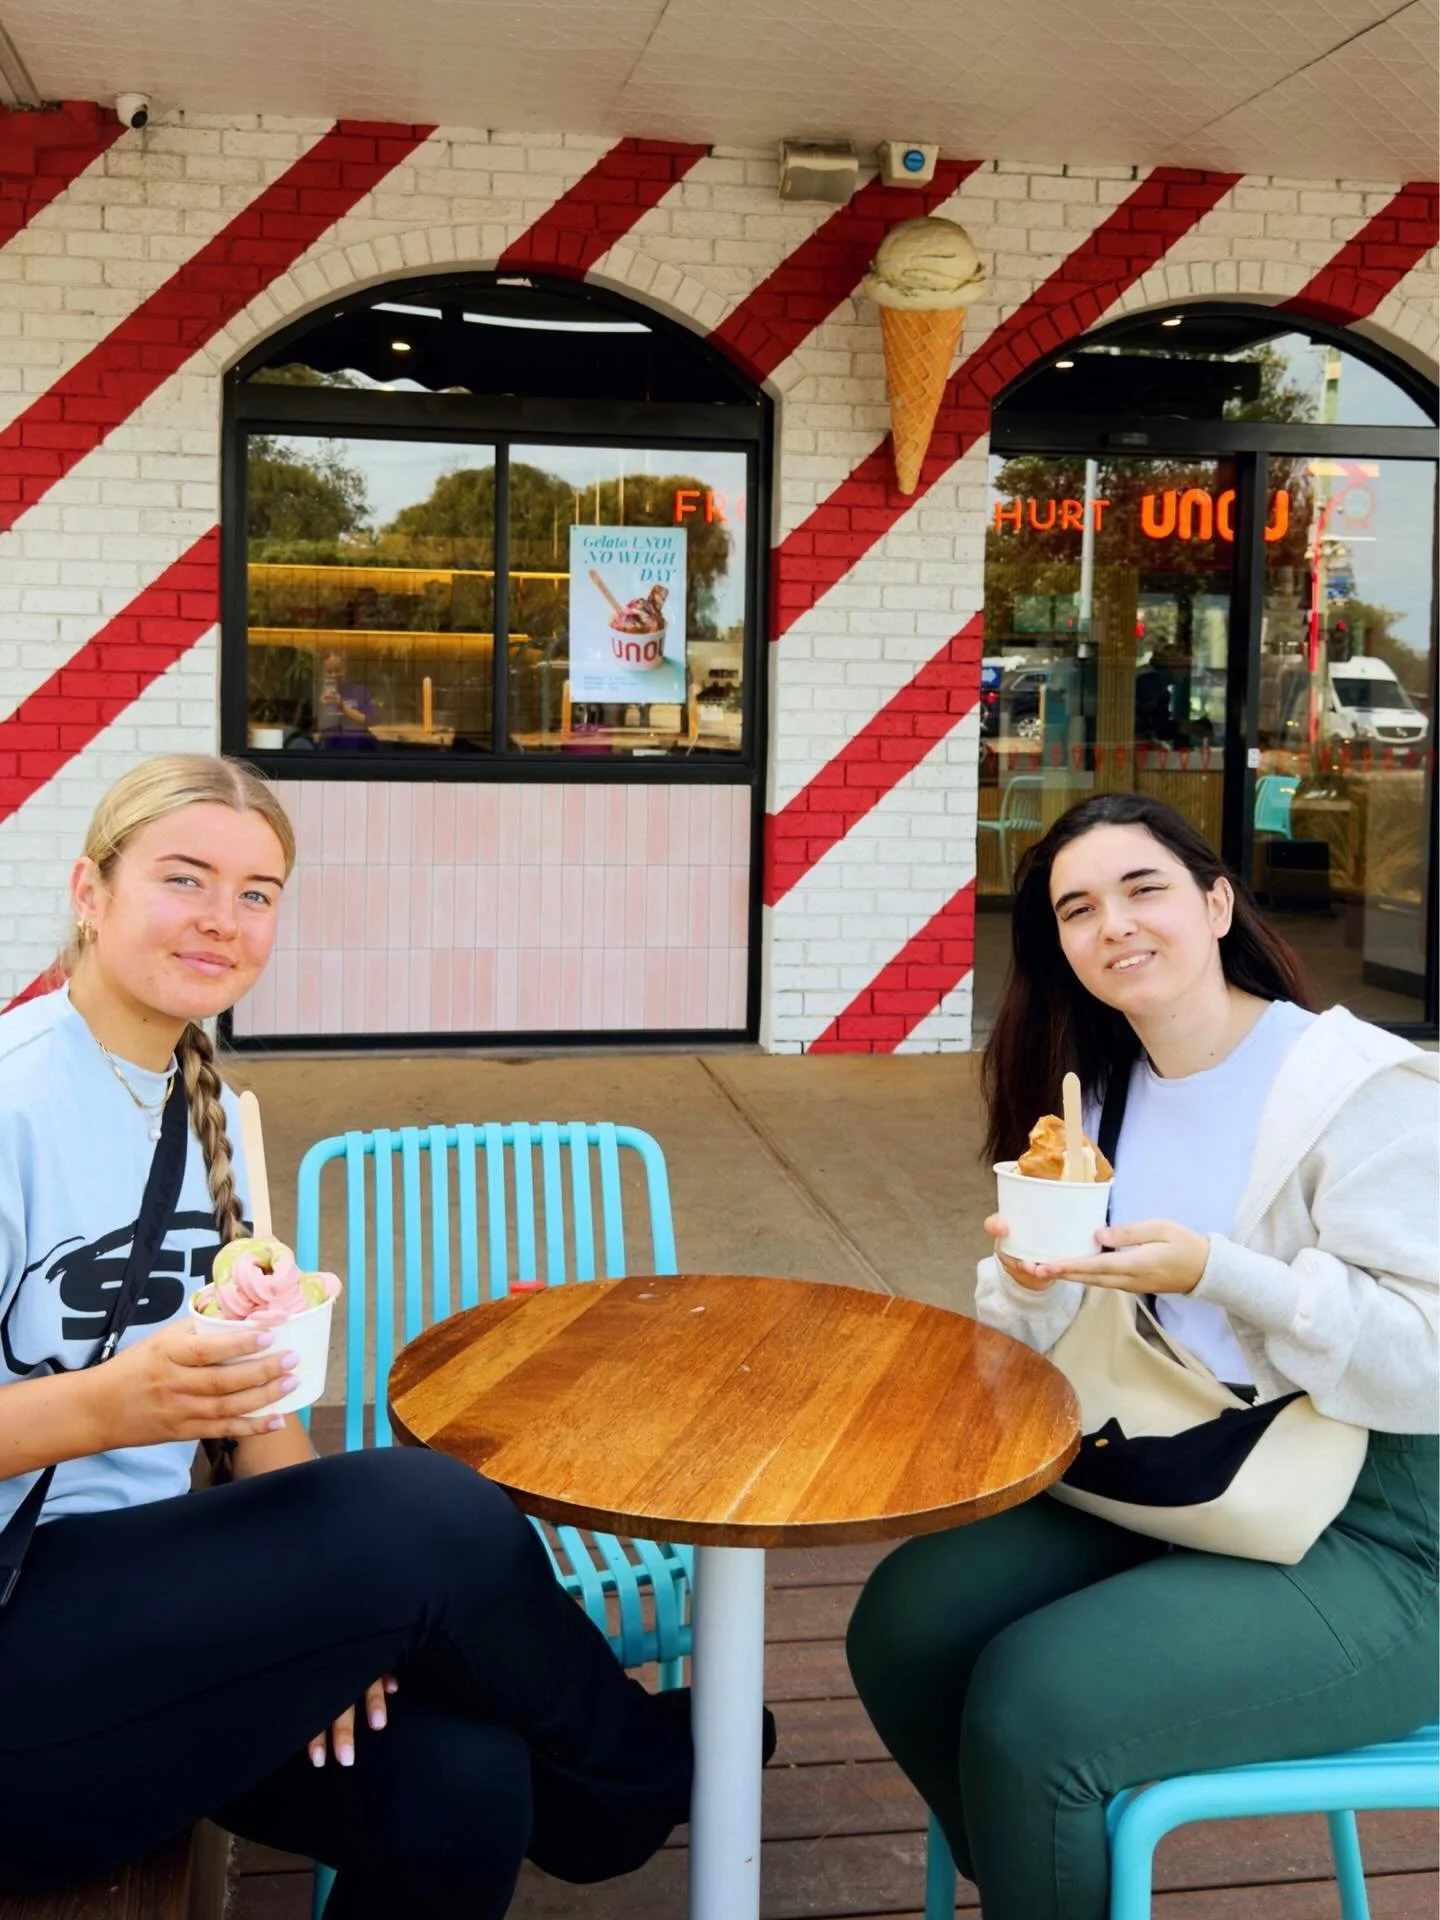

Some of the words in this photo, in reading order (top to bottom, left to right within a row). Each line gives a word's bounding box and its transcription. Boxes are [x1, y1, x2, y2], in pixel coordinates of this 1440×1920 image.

[583, 535, 628, 549] Gelato
[584, 551, 613, 563] NO
[618, 551, 676, 566] WEIGH
[640, 568, 677, 582] DAY
